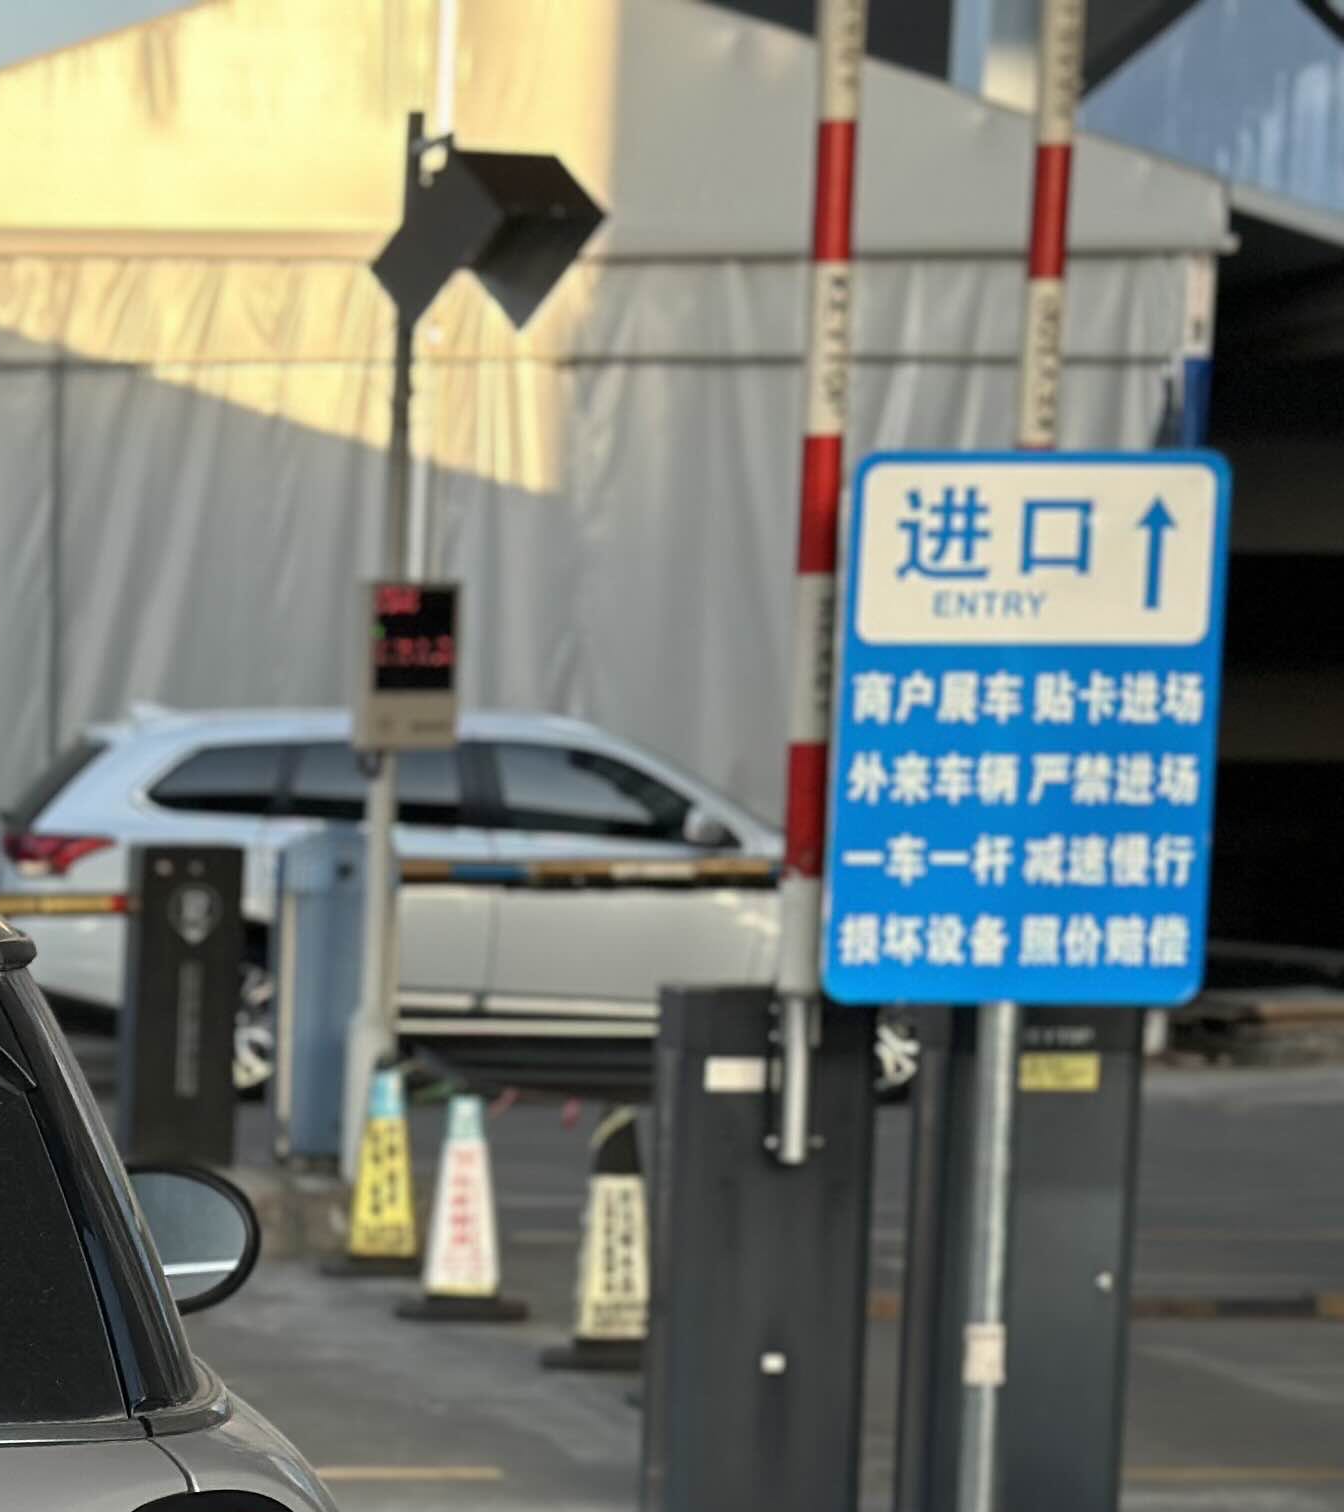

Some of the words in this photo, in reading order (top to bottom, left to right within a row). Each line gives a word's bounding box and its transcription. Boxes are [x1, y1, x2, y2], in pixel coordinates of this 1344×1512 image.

[896, 485, 1094, 580] 进口
[932, 590, 1046, 618] ENTRY
[1032, 670, 1206, 726] 贴卡进场
[847, 750, 1021, 807] 外来车辆
[1026, 752, 1201, 807] 严禁进场
[841, 832, 1014, 888] 一车一杆
[1021, 832, 1197, 888] 减速慢行
[838, 912, 1010, 969] 损坏设备
[1018, 913, 1191, 969] 照价赔偿
